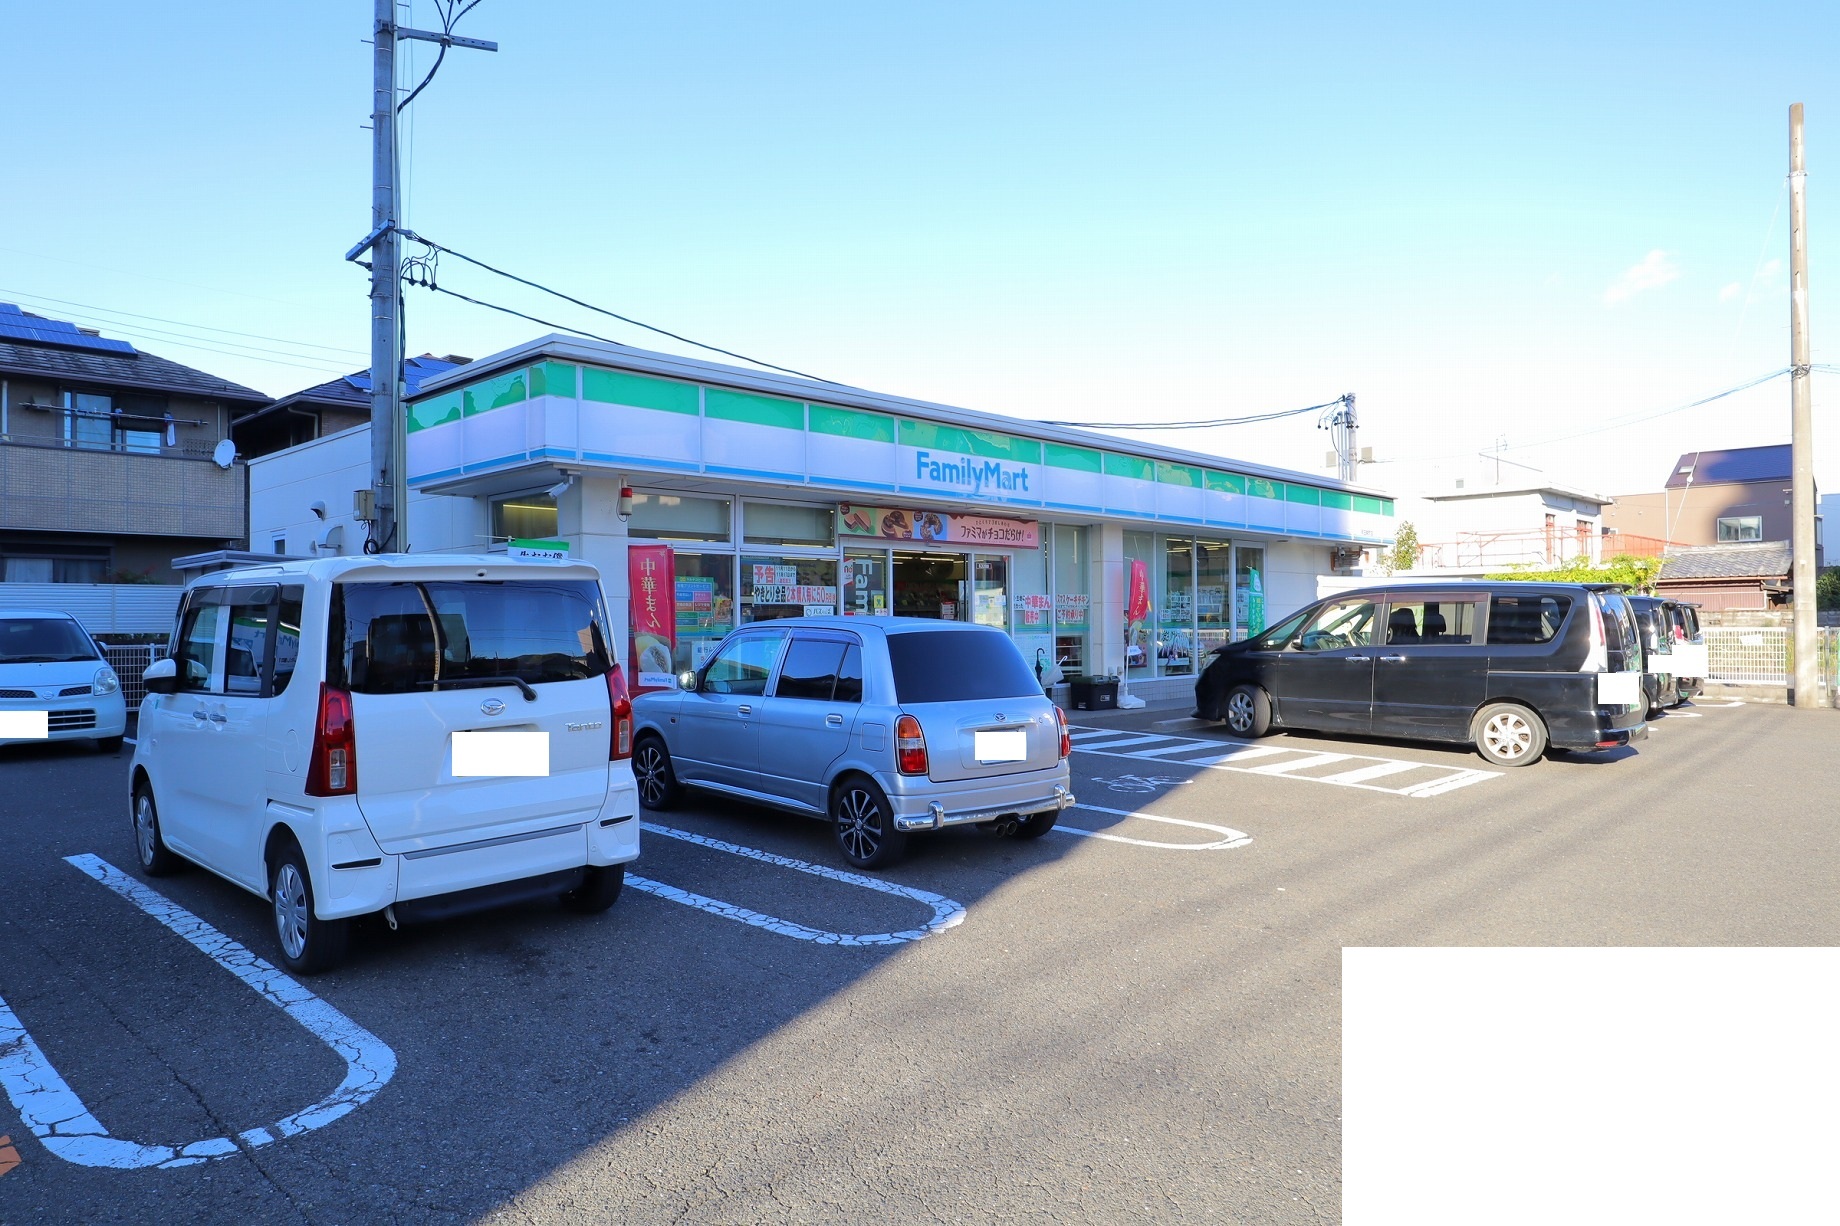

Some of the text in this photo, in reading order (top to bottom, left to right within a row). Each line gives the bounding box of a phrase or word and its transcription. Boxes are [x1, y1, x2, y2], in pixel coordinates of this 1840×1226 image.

[916, 451, 1029, 495] FamilyMart
[754, 565, 774, 584] 予告
[1024, 595, 1051, 609] 中華まん
[1025, 610, 1039, 624] 販売中
[565, 721, 603, 733] Tanto
